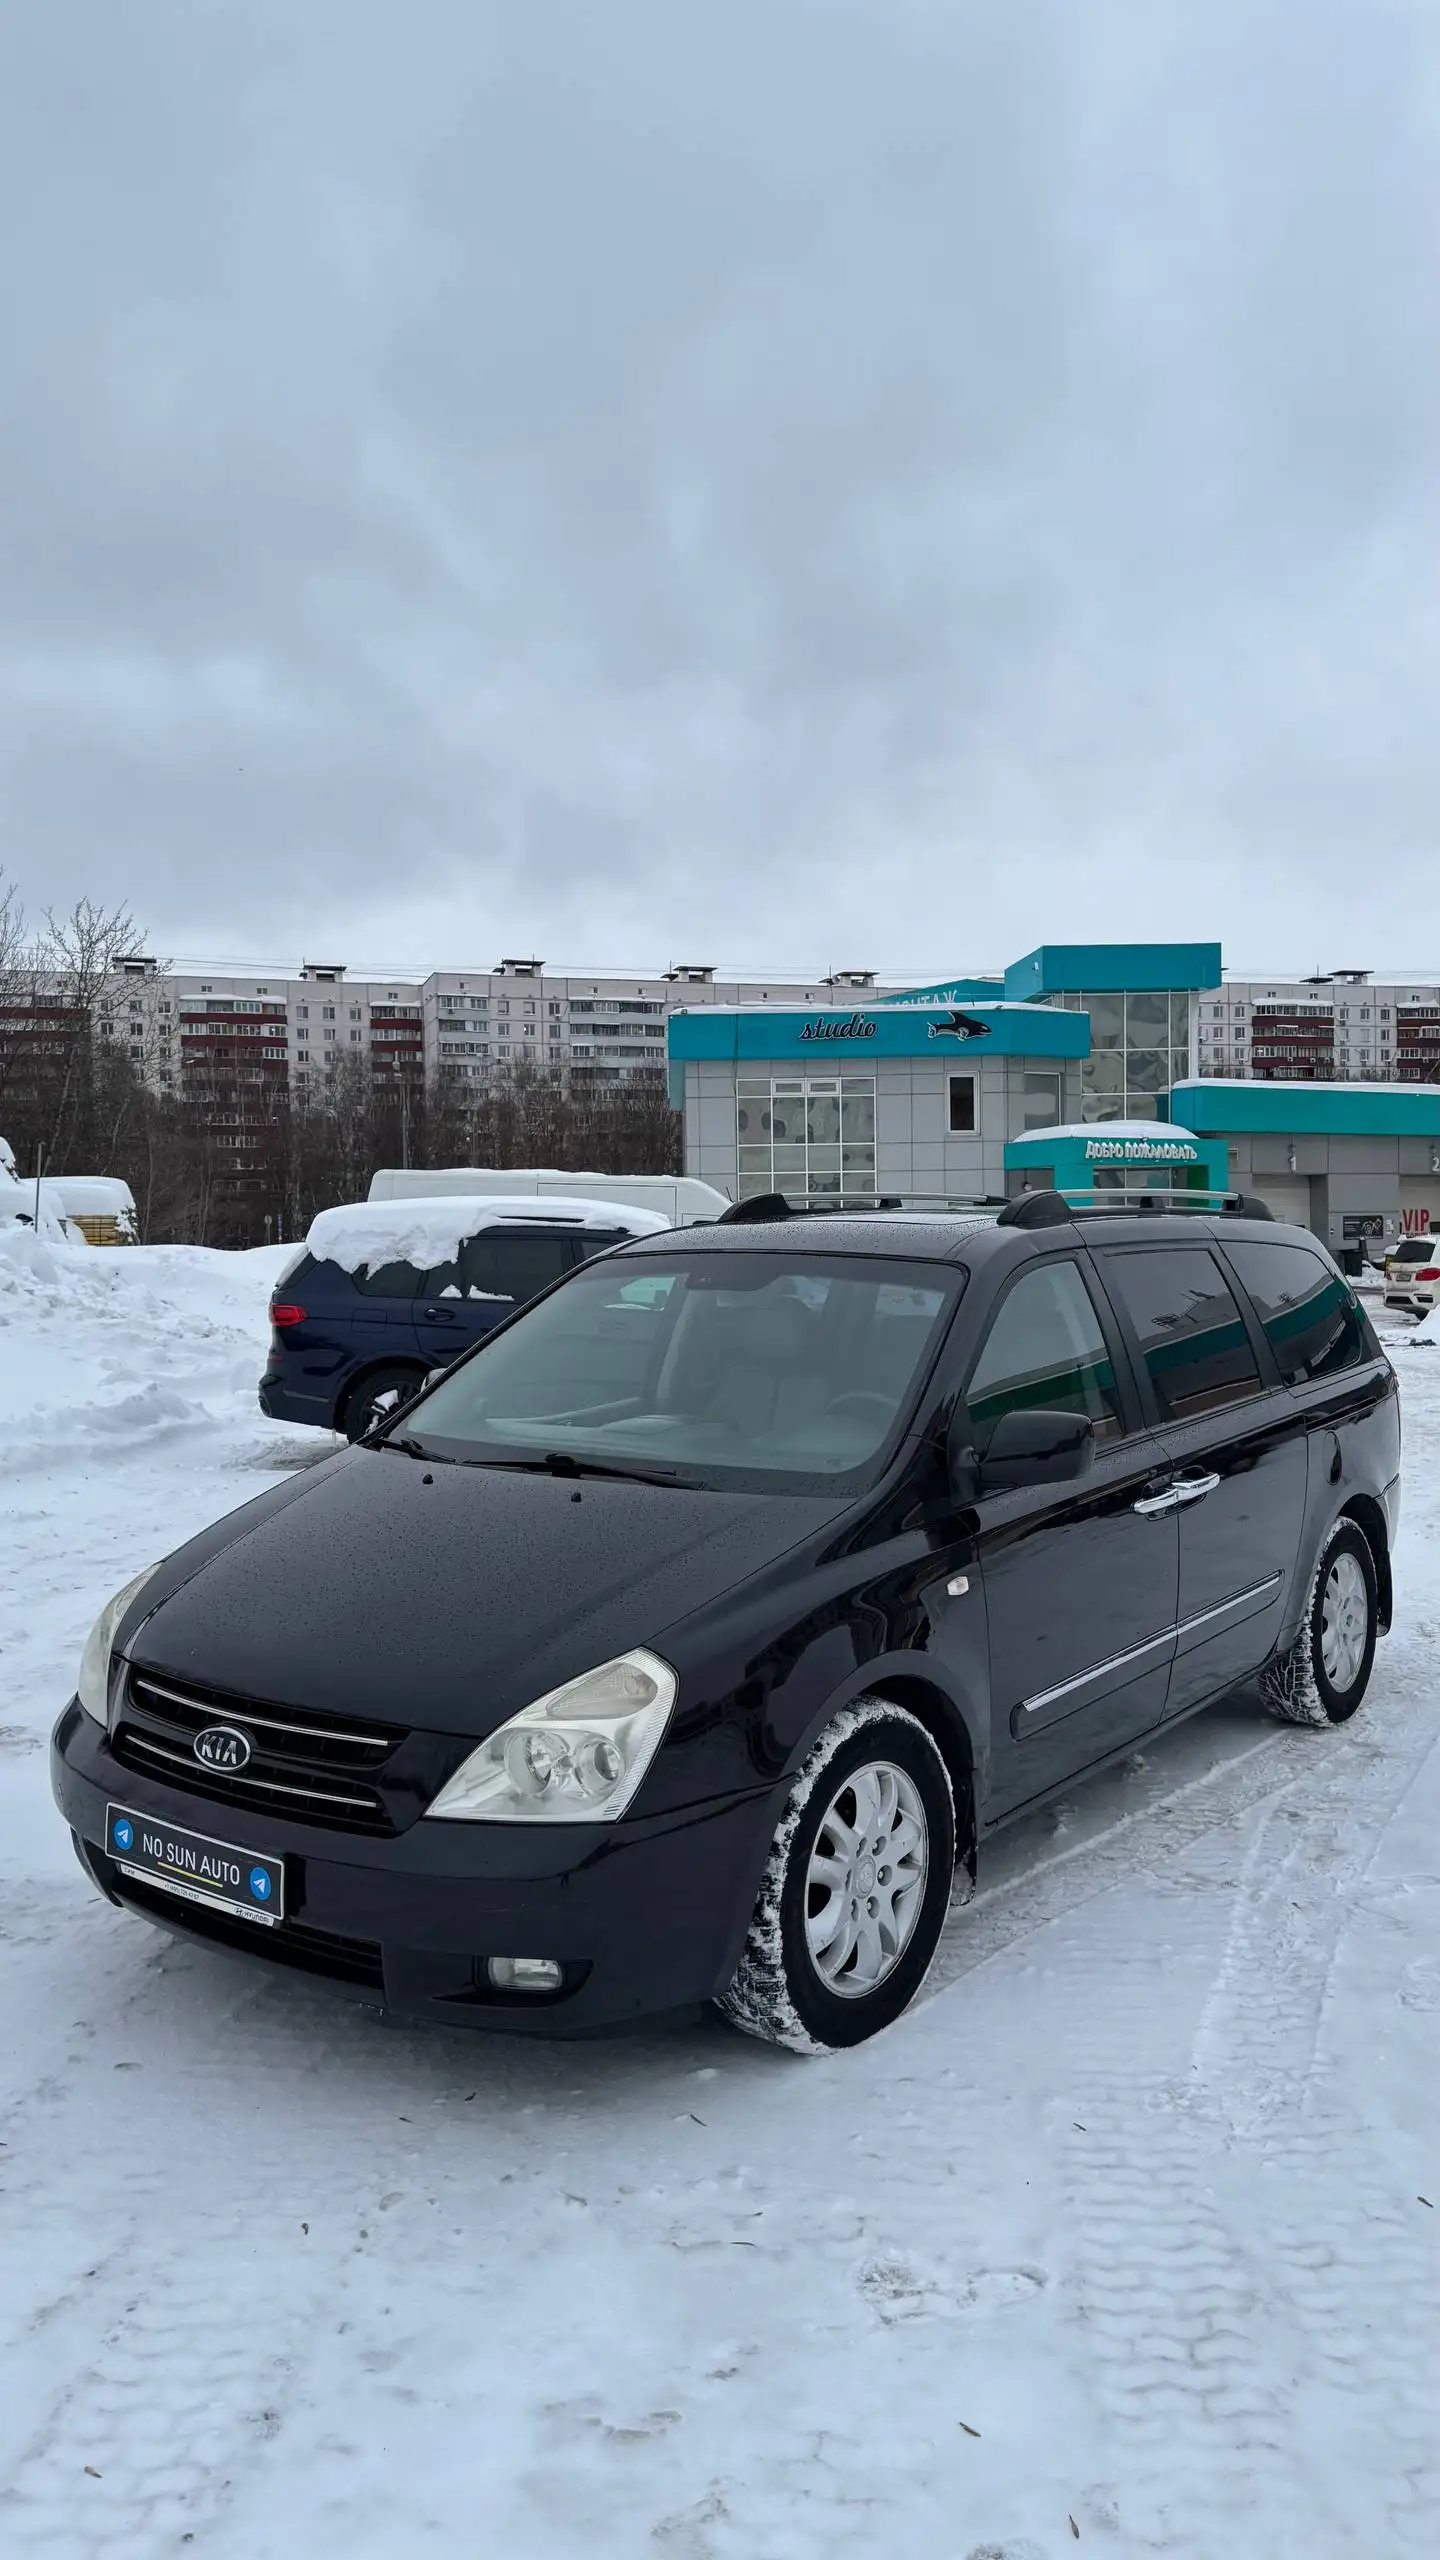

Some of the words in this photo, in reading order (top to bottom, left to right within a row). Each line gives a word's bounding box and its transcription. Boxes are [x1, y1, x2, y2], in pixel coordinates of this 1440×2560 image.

[799, 1013, 877, 1040] studio
[1085, 1140, 1124, 1159] ДОБРО
[1124, 1141, 1198, 1160] ПОЖАЛОВАТЬ
[1289, 1155, 1297, 1171] 1
[1431, 1157, 1440, 1172] 2
[1402, 1208, 1430, 1232] VIP
[201, 1733, 238, 1765] KIA
[143, 1833, 163, 1859] NO
[166, 1842, 196, 1871] SUN
[199, 1855, 240, 1886] AUTO
